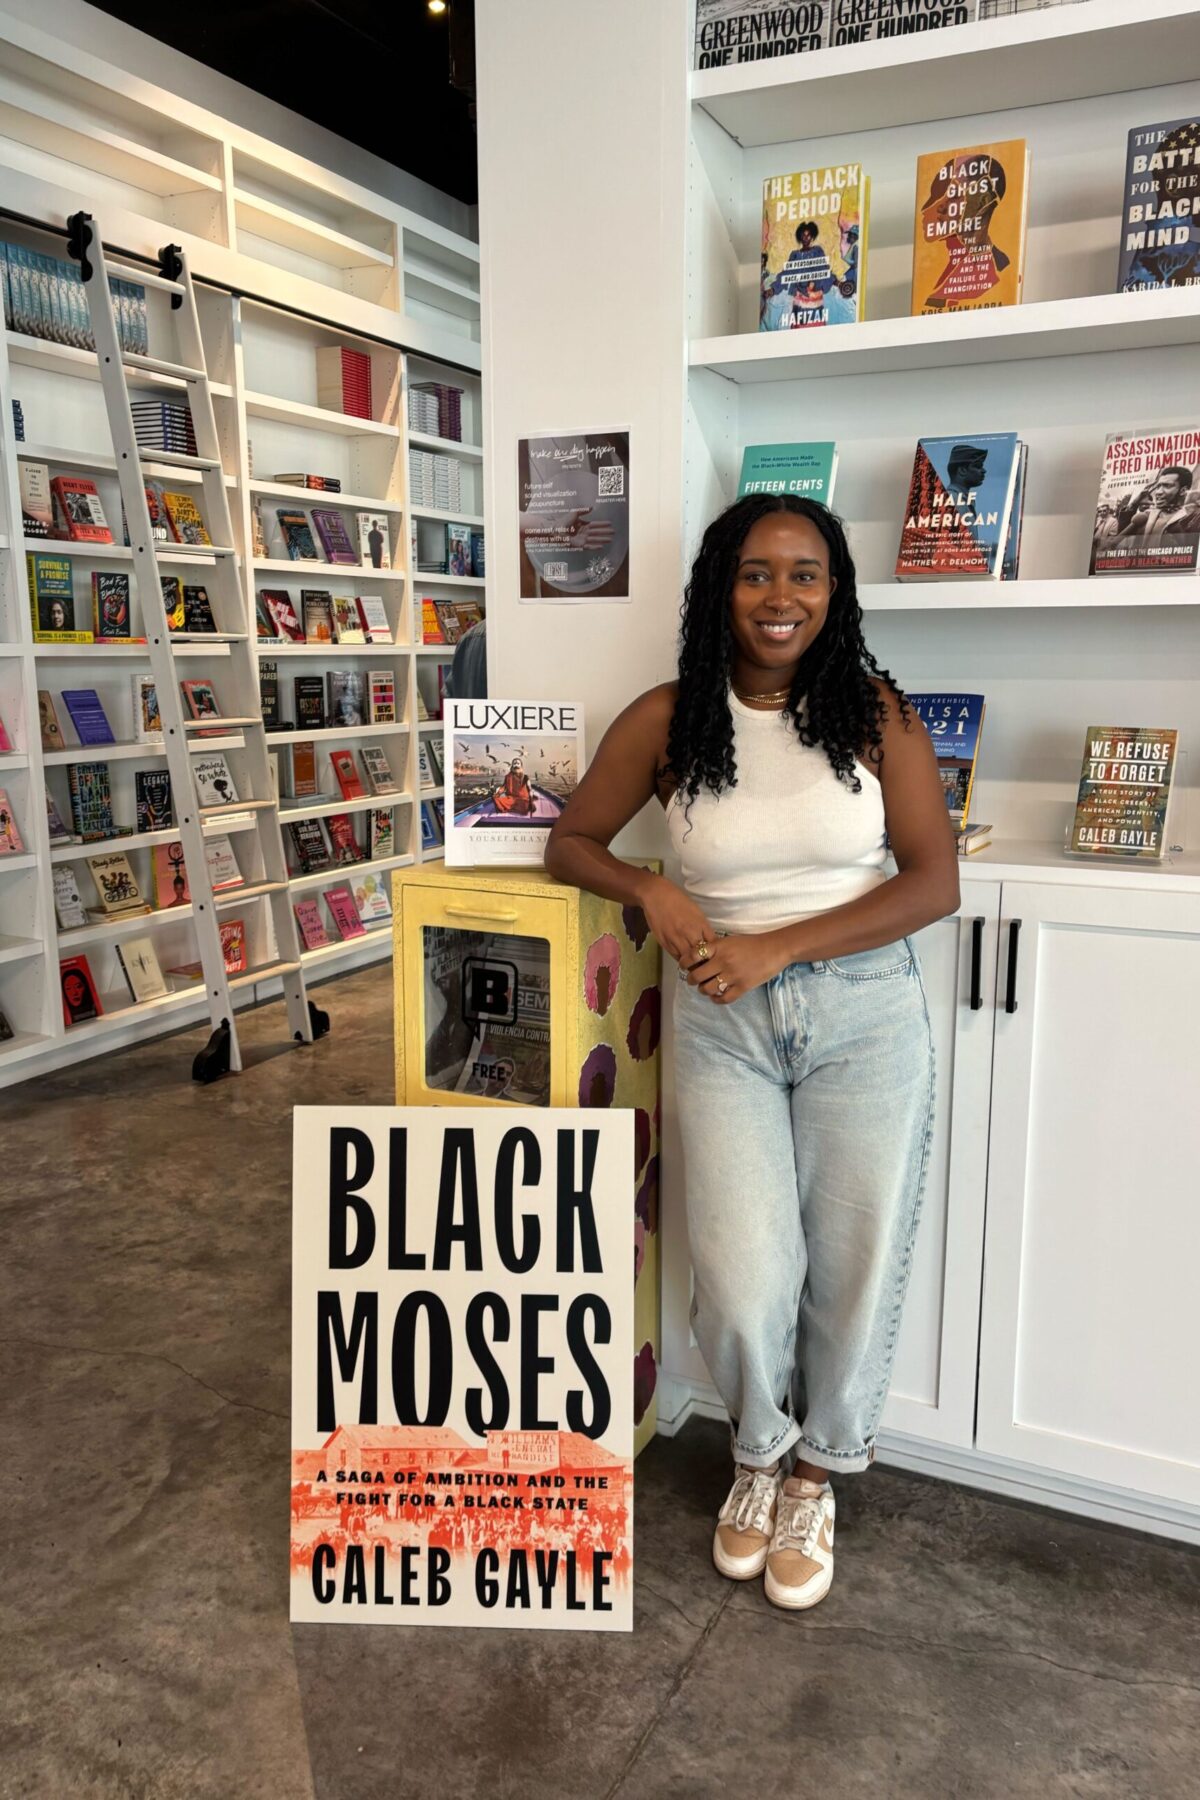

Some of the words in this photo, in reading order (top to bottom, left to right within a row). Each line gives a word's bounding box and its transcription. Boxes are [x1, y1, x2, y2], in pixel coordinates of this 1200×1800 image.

[700, 3, 823, 51] GREENWOOD
[836, 23, 872, 47] ONE
[877, 6, 968, 40] HUNDRED
[699, 48, 733, 70] ONE
[738, 34, 822, 63] HUNDRED
[1135, 130, 1166, 147] THE
[939, 160, 990, 181] BLACK
[763, 176, 792, 200] THE
[801, 164, 859, 194] BLACK
[947, 177, 999, 198] GHOST
[1131, 180, 1160, 196] FOR
[1166, 174, 1198, 191] THE
[776, 193, 841, 222] PERIOD
[948, 201, 967, 216] OF
[926, 216, 982, 237] EMPIRE
[964, 237, 976, 245] THE
[1126, 226, 1190, 251] MIND
[948, 247, 966, 256] LONG
[968, 245, 991, 254] DEATH
[952, 257, 960, 265] OF
[963, 253, 992, 264] SLAVERY
[960, 265, 974, 273] AND
[977, 264, 989, 272] THE
[949, 275, 976, 284] FAILURE
[979, 273, 988, 281] OF
[943, 282, 992, 295] EMANCIPATION
[781, 309, 829, 327] HAFIZAH
[1107, 431, 1200, 460] ASSASSINATION
[1112, 458, 1141, 475] FRED
[744, 480, 786, 493] FIFTEEN
[789, 478, 824, 491] CENTS
[1107, 480, 1132, 489] JEFFREY
[932, 491, 977, 507] HALF
[905, 511, 999, 529] AMERICAN
[1147, 547, 1172, 556] CHICAGO
[1173, 546, 1193, 554] POLICE
[902, 558, 938, 567] MATTHEW
[949, 558, 988, 566] DELMONT
[453, 705, 577, 731] LUXIERE
[1091, 741, 1112, 757] WE
[1116, 742, 1170, 760] REFUSE
[143, 775, 169, 785] LEGACY
[1089, 763, 1106, 779] TO
[1111, 763, 1166, 782] FORGET
[1079, 827, 1116, 843] CALEB
[1120, 830, 1157, 846] GAYLE
[490, 1024, 525, 1038] VIOLENCIA
[472, 1062, 506, 1081] FREE
[328, 1126, 604, 1274] BLACK
[316, 1290, 612, 1441] MOSES
[316, 1470, 328, 1483] A
[335, 1470, 385, 1484] SAGA
[394, 1471, 417, 1484] OF
[425, 1472, 518, 1487] AMBITION
[527, 1475, 566, 1488] AND
[574, 1476, 609, 1489] THE
[336, 1493, 390, 1506] FIGHT
[400, 1493, 436, 1507] FOR
[444, 1495, 455, 1507] A
[464, 1495, 524, 1509] BLACK
[532, 1497, 588, 1510] STATE
[311, 1543, 451, 1606] CALEB
[475, 1548, 613, 1611] GAYLE
